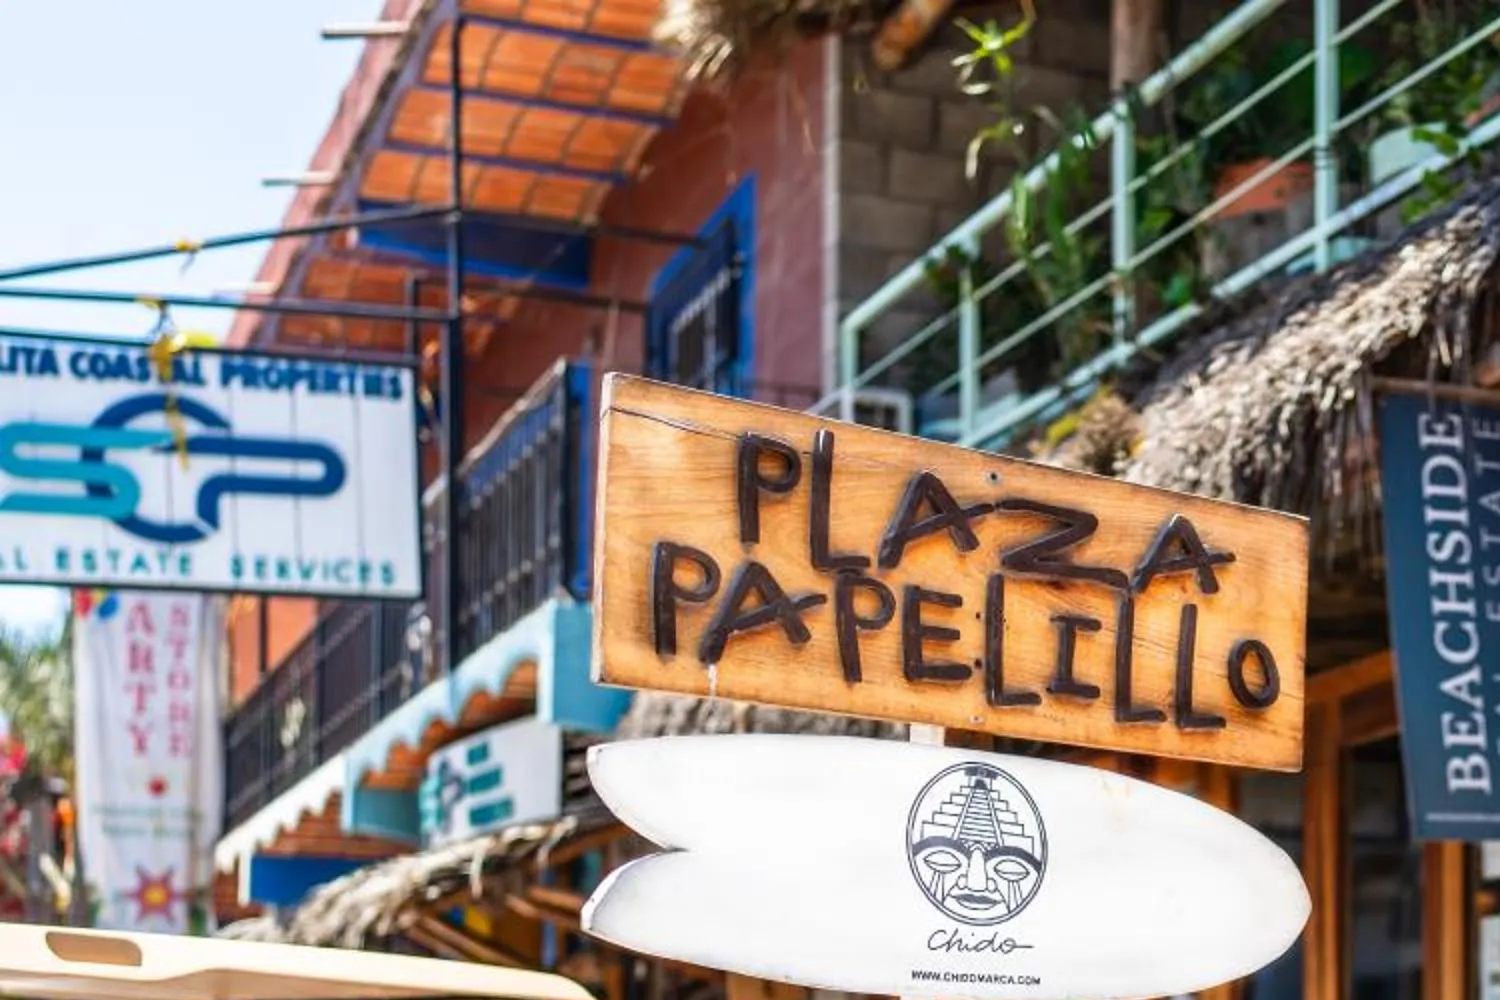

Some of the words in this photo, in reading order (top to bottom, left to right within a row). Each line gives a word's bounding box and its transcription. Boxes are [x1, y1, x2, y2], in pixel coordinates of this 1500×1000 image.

[221, 361, 402, 399] PROPERTIES
[737, 428, 1237, 596] PLAZA
[56, 547, 192, 576] ESTATE
[230, 554, 396, 585] SERVICES
[1418, 412, 1493, 795] BEACHSIDE
[650, 541, 1282, 730] PAPELILLO
[927, 928, 1035, 954] Chido
